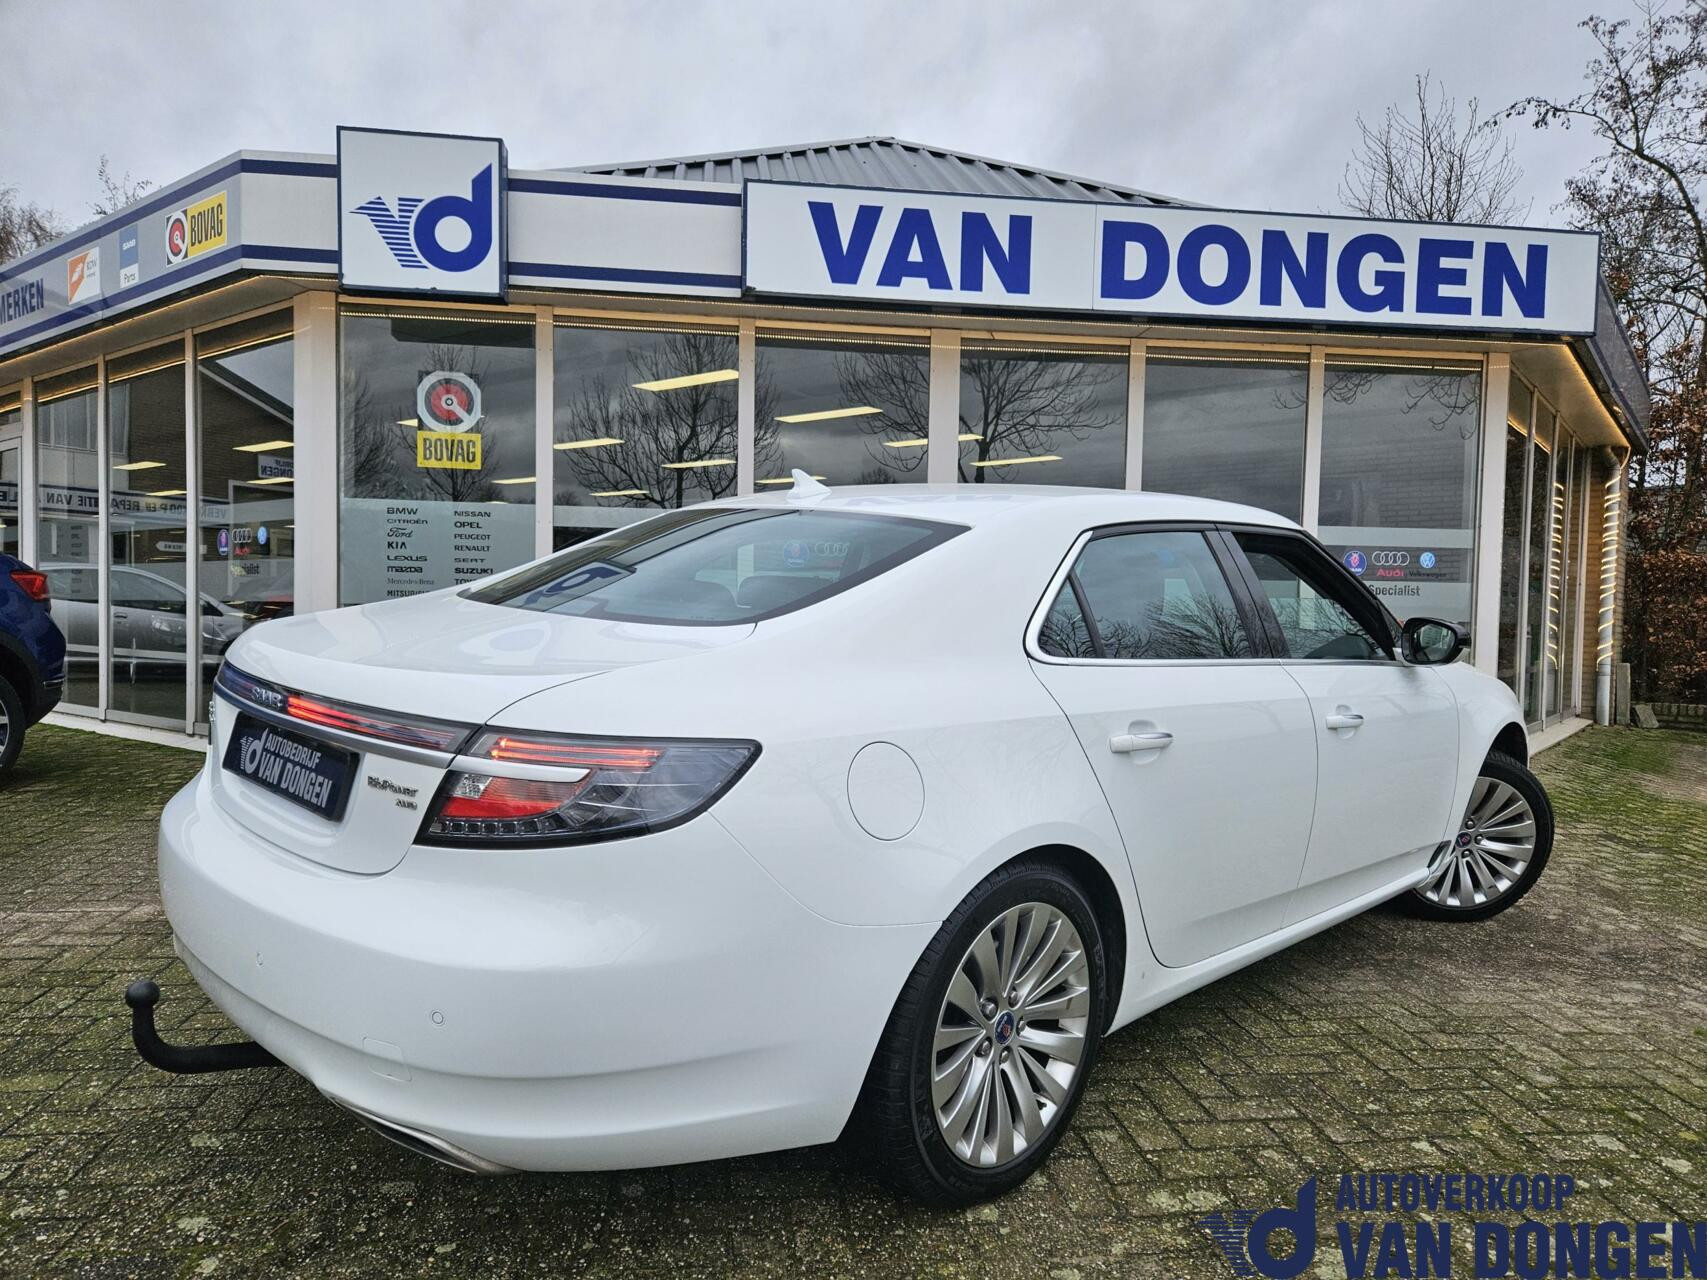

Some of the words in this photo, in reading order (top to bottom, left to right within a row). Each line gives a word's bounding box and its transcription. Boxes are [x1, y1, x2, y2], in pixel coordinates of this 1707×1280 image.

[190, 202, 223, 246] BOVAG
[807, 201, 1033, 295] VAN
[1101, 220, 1548, 319] DONGEN
[422, 437, 476, 463] BOVAG
[386, 507, 418, 516] BMW
[454, 510, 491, 518] NISSAN
[454, 521, 483, 529] OPEL
[387, 527, 413, 538] Ford
[387, 541, 407, 550] KIA
[454, 567, 494, 575] SUZUKI
[1376, 568, 1404, 577] Audi
[264, 733, 322, 769] AUTOBEDRIJF
[258, 751, 284, 785] VAN
[280, 762, 333, 808] DONGEN
